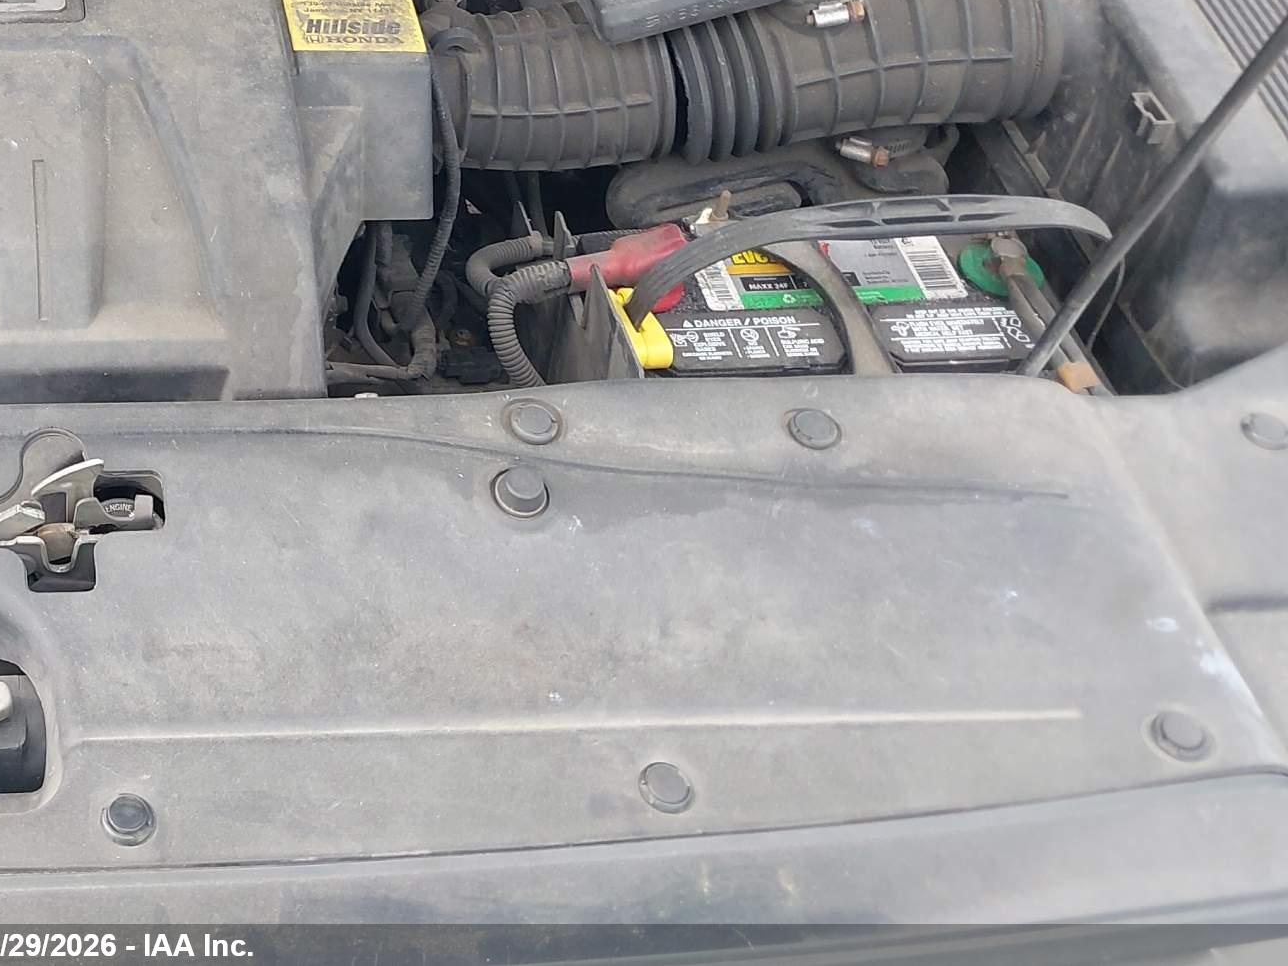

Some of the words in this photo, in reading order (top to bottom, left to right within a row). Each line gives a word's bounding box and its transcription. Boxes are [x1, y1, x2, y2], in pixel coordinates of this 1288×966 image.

[306, 19, 401, 35] Hillside
[324, 35, 405, 44] HONDA
[695, 318, 742, 327] DANGER
[753, 316, 797, 325] POISON
